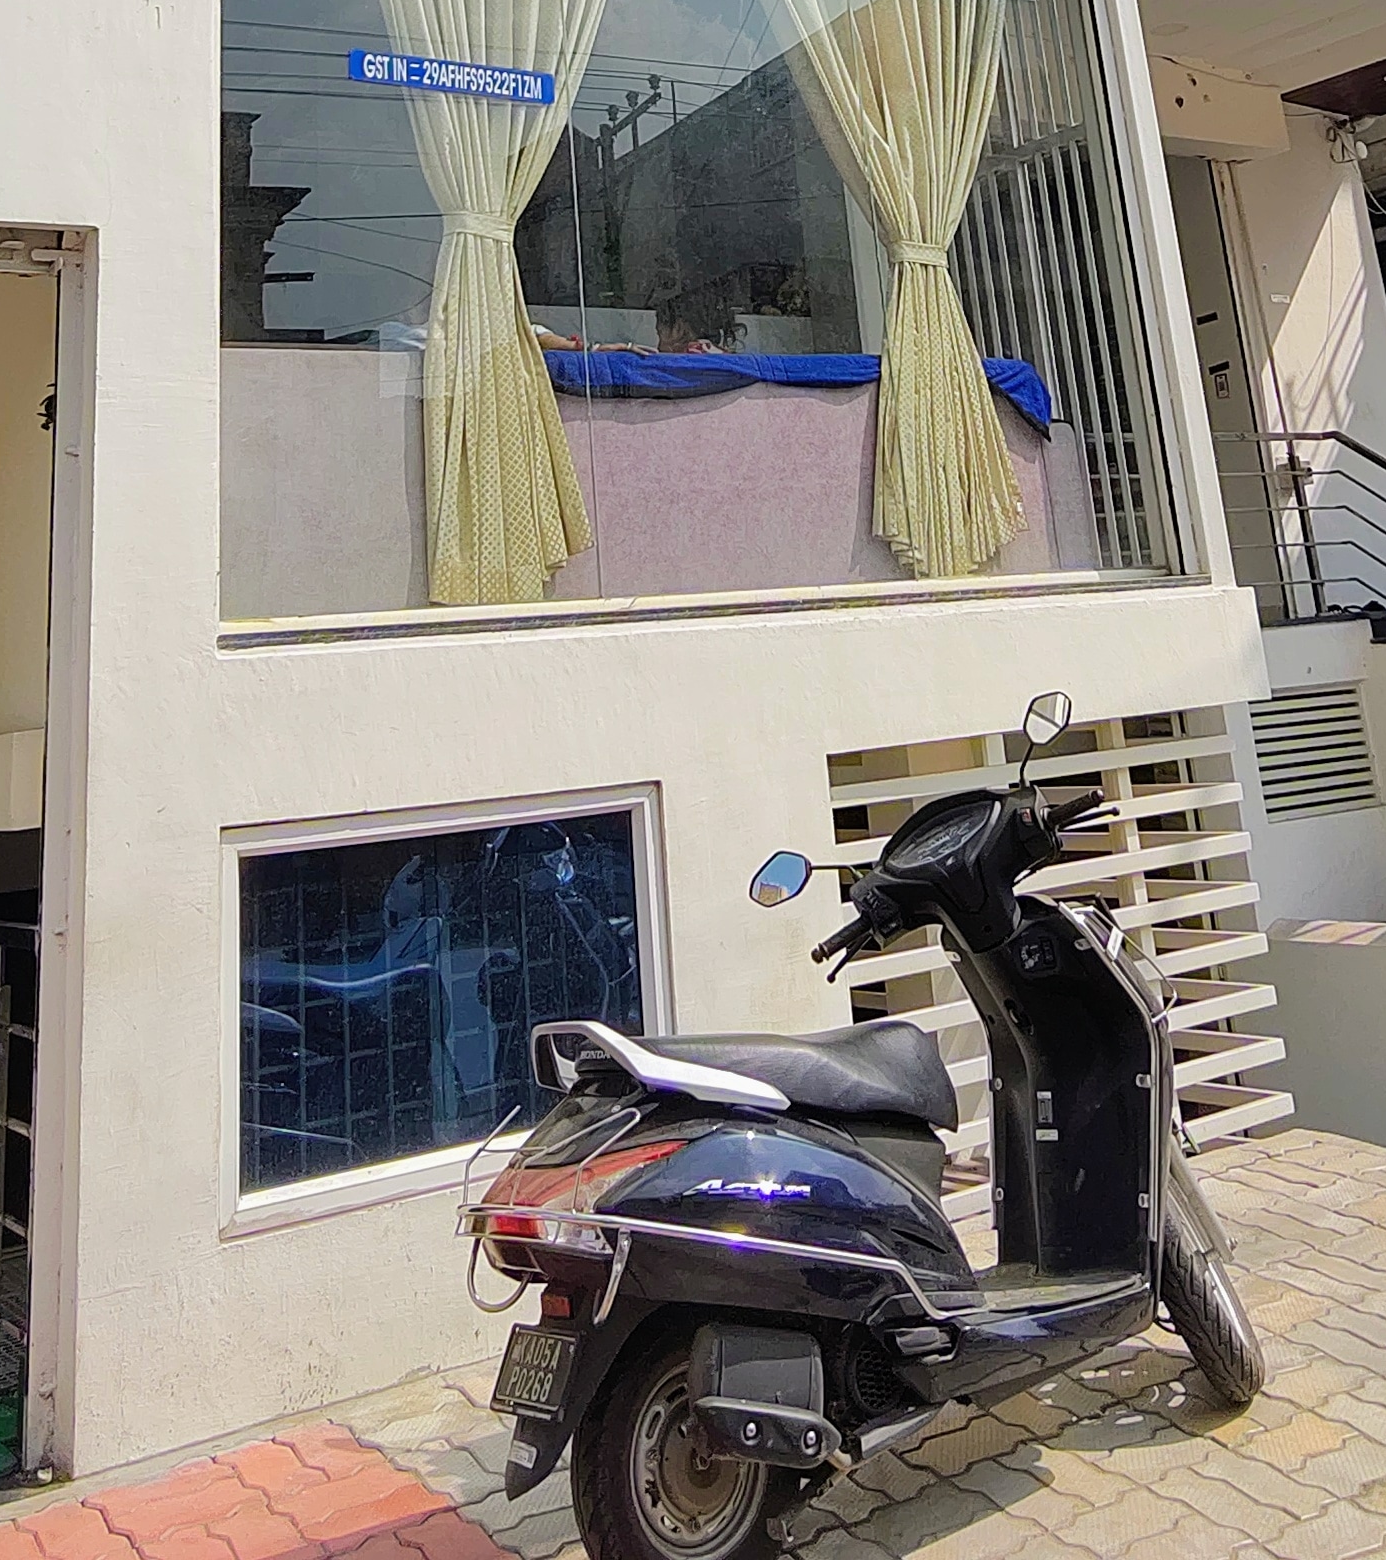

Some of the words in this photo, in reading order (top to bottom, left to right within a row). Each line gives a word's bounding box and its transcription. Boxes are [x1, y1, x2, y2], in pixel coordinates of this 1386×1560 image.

[363, 53, 391, 79] GST
[392, 57, 408, 82] IN
[422, 60, 543, 100] 29AFHFS9522F1ZM
[506, 1366, 554, 1403] P0268
